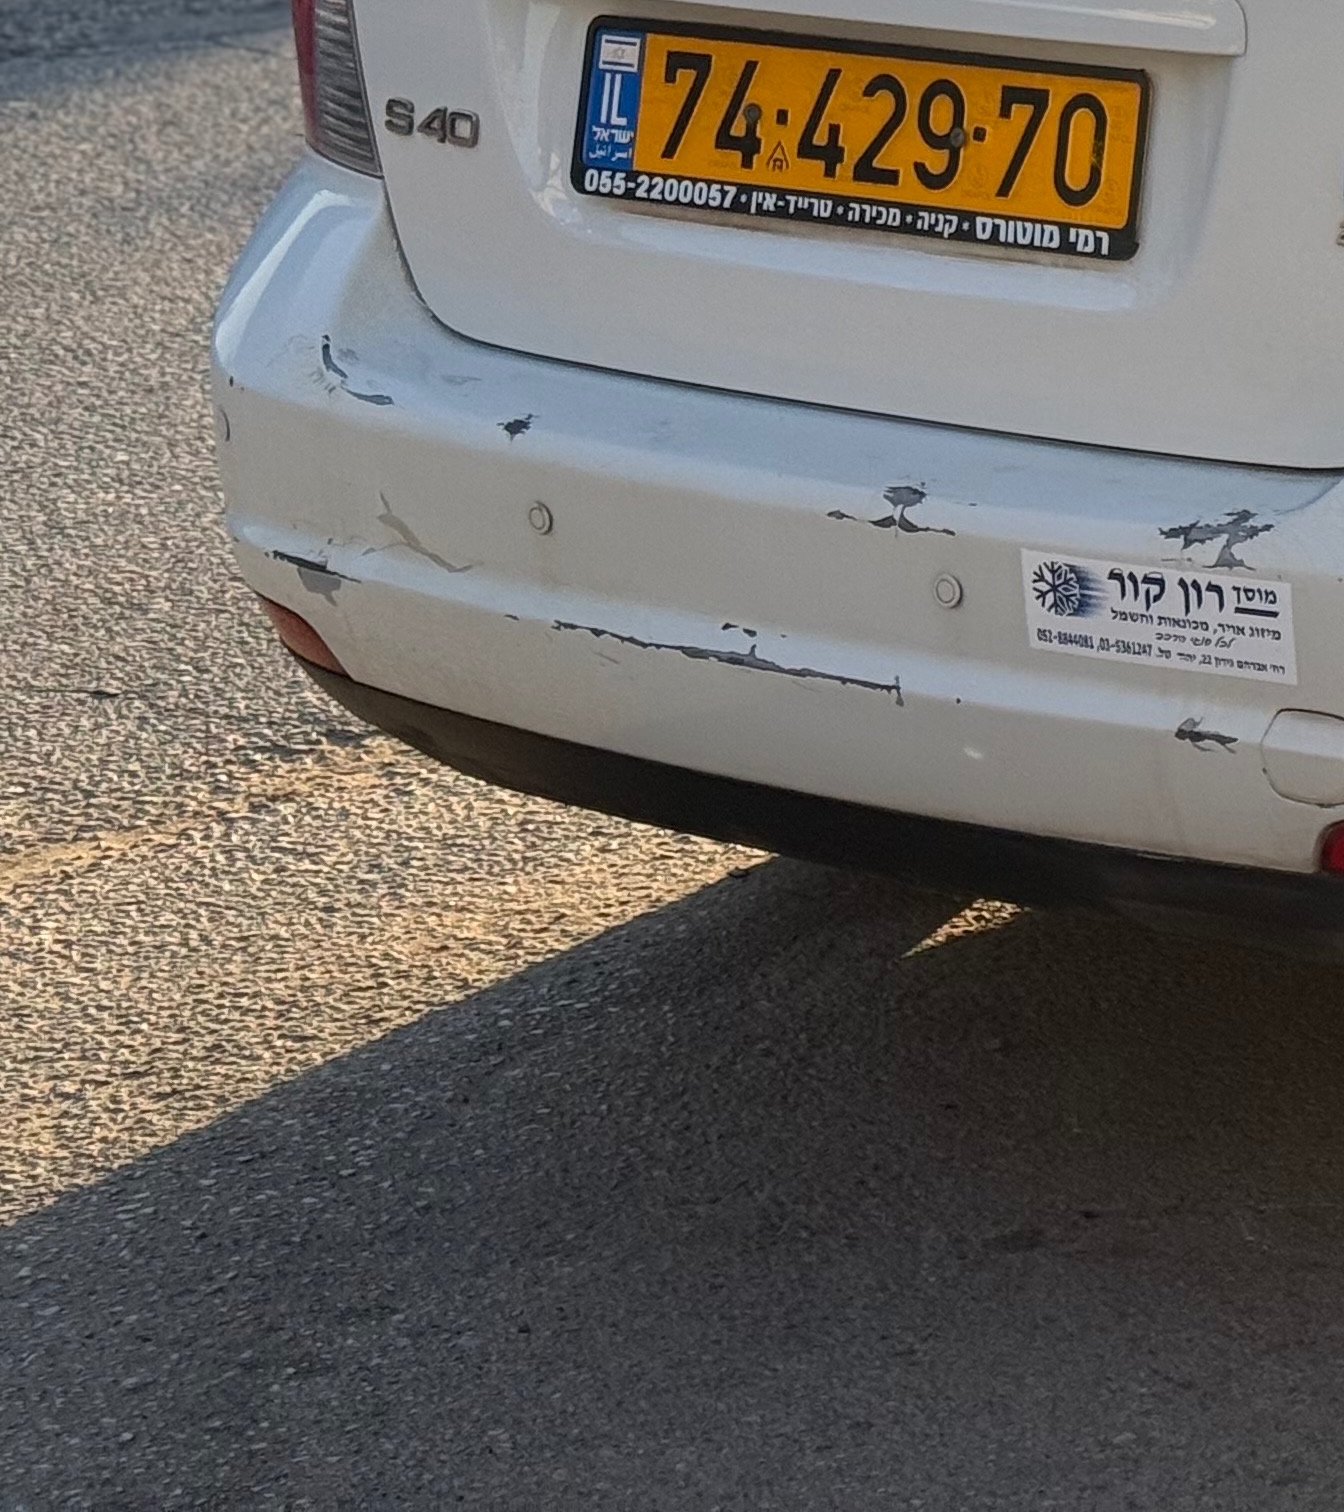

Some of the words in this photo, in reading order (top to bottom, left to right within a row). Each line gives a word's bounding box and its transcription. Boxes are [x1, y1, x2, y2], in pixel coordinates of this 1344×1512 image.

[600, 72, 628, 127] IL
[384, 97, 481, 149] S40
[592, 125, 635, 144] ישראל
[583, 168, 737, 209] 055-2200057
[846, 203, 901, 228] מכירה
[915, 211, 959, 239] קניה
[974, 216, 1061, 250] מוטורס
[1068, 230, 1111, 256] רמי
[1107, 567, 1167, 612] קור
[1177, 576, 1226, 616] רון
[1231, 584, 1278, 605] מוסך
[1110, 607, 1154, 625] וחשמל
[1156, 614, 1209, 632] מכונאות
[1155, 632, 1187, 644] הרכב
[1248, 625, 1282, 641] מיזוג
